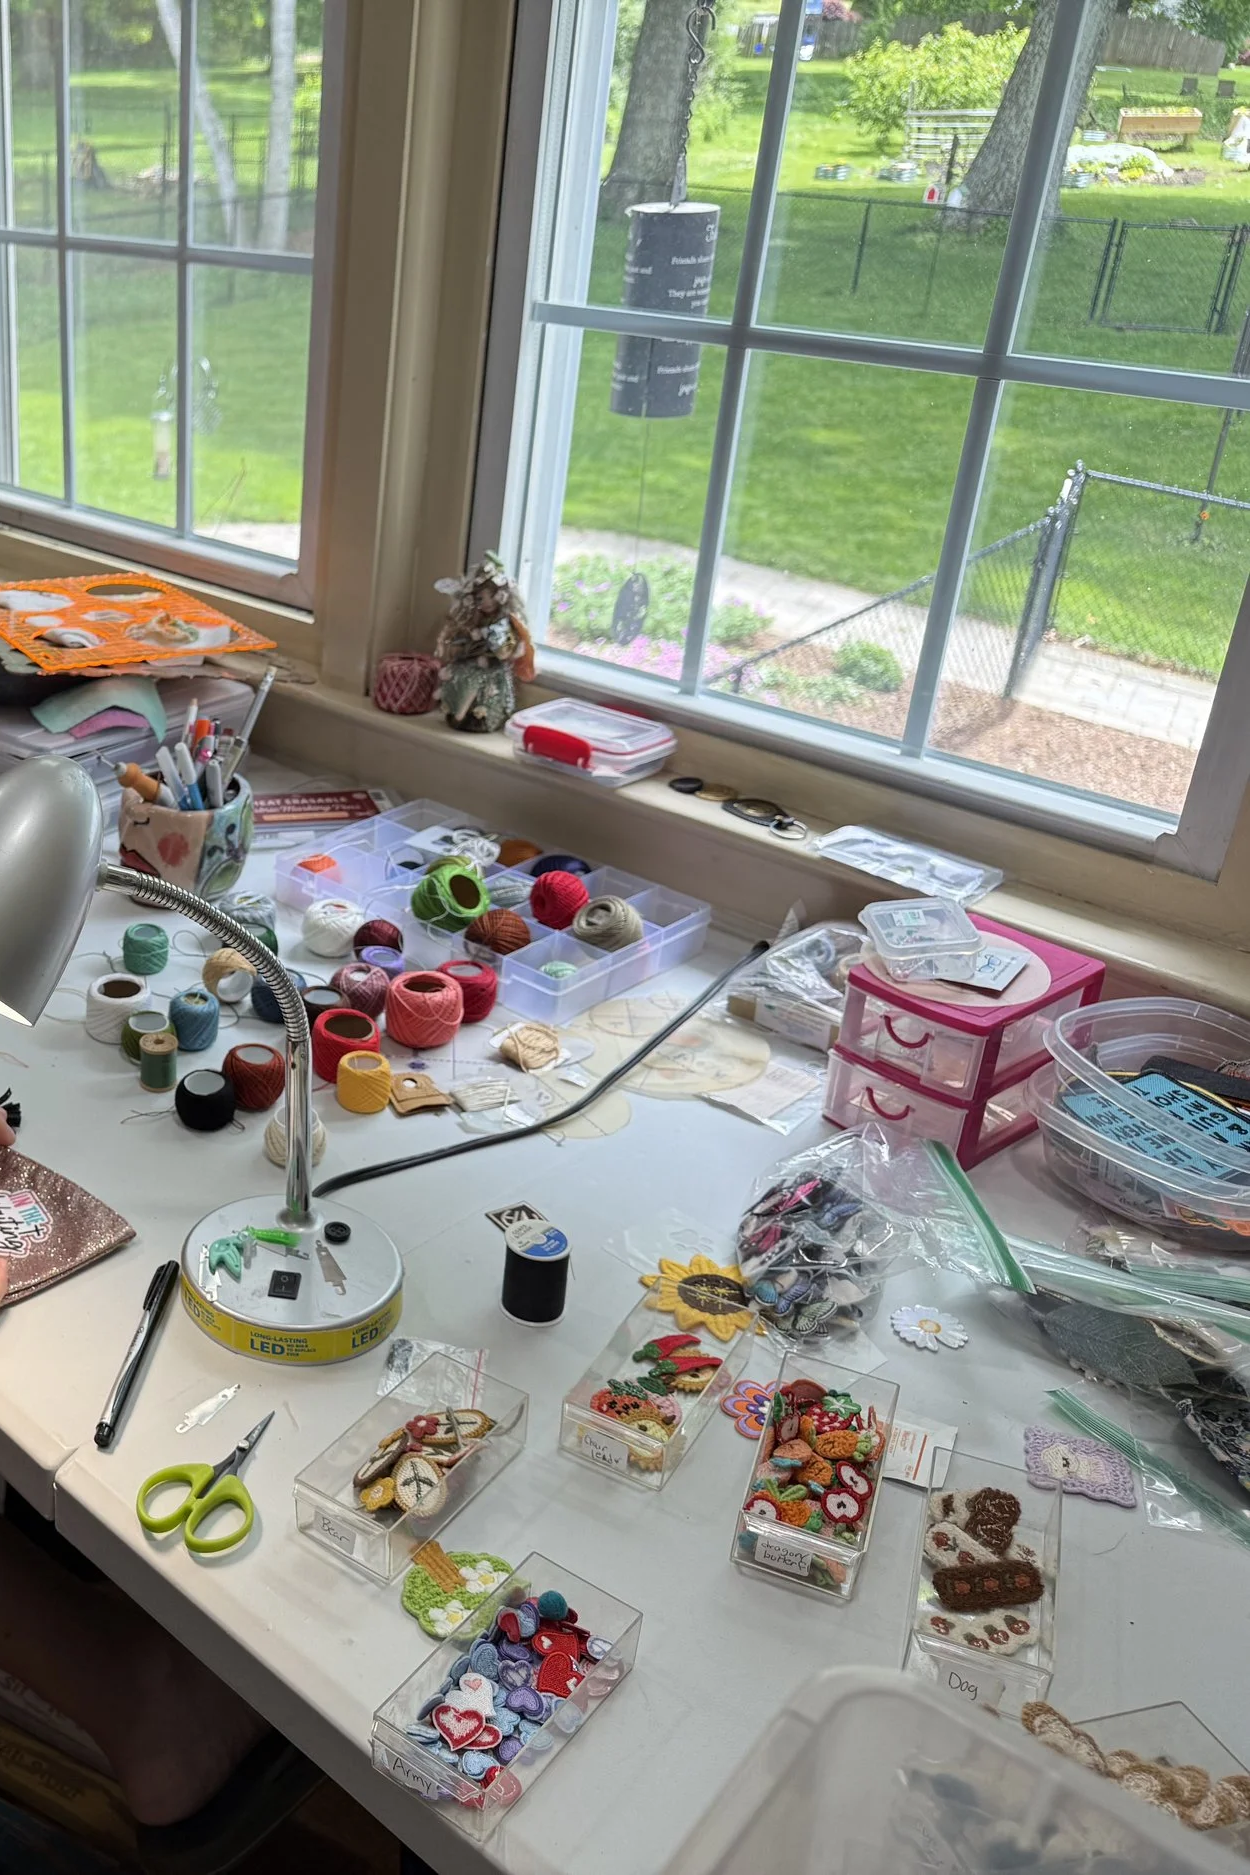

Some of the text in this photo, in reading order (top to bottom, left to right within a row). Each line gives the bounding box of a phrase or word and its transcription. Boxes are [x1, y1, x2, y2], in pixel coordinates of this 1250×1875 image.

[18, 1205, 45, 1226] THE
[250, 1331, 308, 1344] LONG-LASTING
[250, 1339, 285, 1355] LED
[351, 1327, 379, 1349] LED
[321, 1516, 350, 1542] Bear
[948, 1671, 979, 1701] Dog
[392, 1757, 432, 1795] Army
